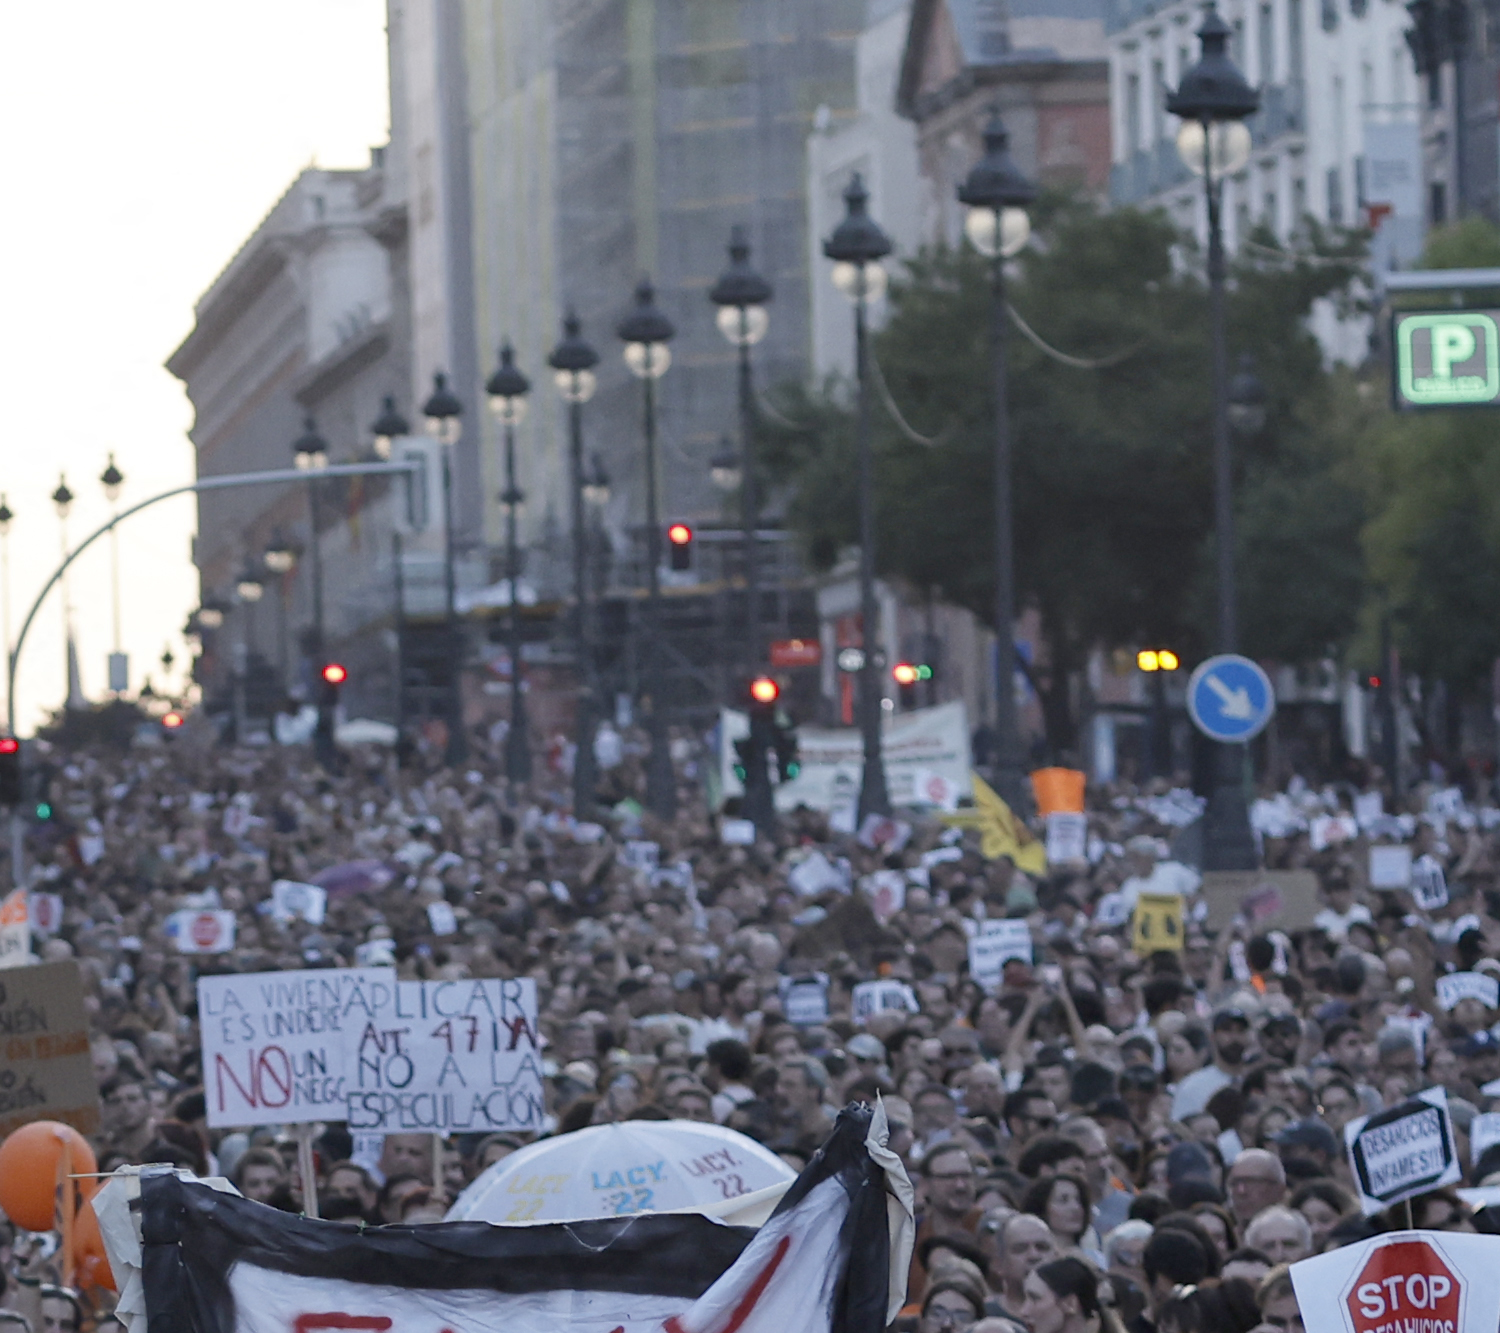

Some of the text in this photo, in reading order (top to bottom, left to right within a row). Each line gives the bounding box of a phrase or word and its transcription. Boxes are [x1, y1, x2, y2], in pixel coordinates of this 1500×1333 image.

[342, 979, 525, 1019] APLICAR
[431, 1016, 478, 1053] 47
[214, 1044, 327, 1112] NO UN
[359, 1051, 542, 1089] NO A LA
[714, 1171, 750, 1198] 22
[1356, 1273, 1452, 1320] STOP
